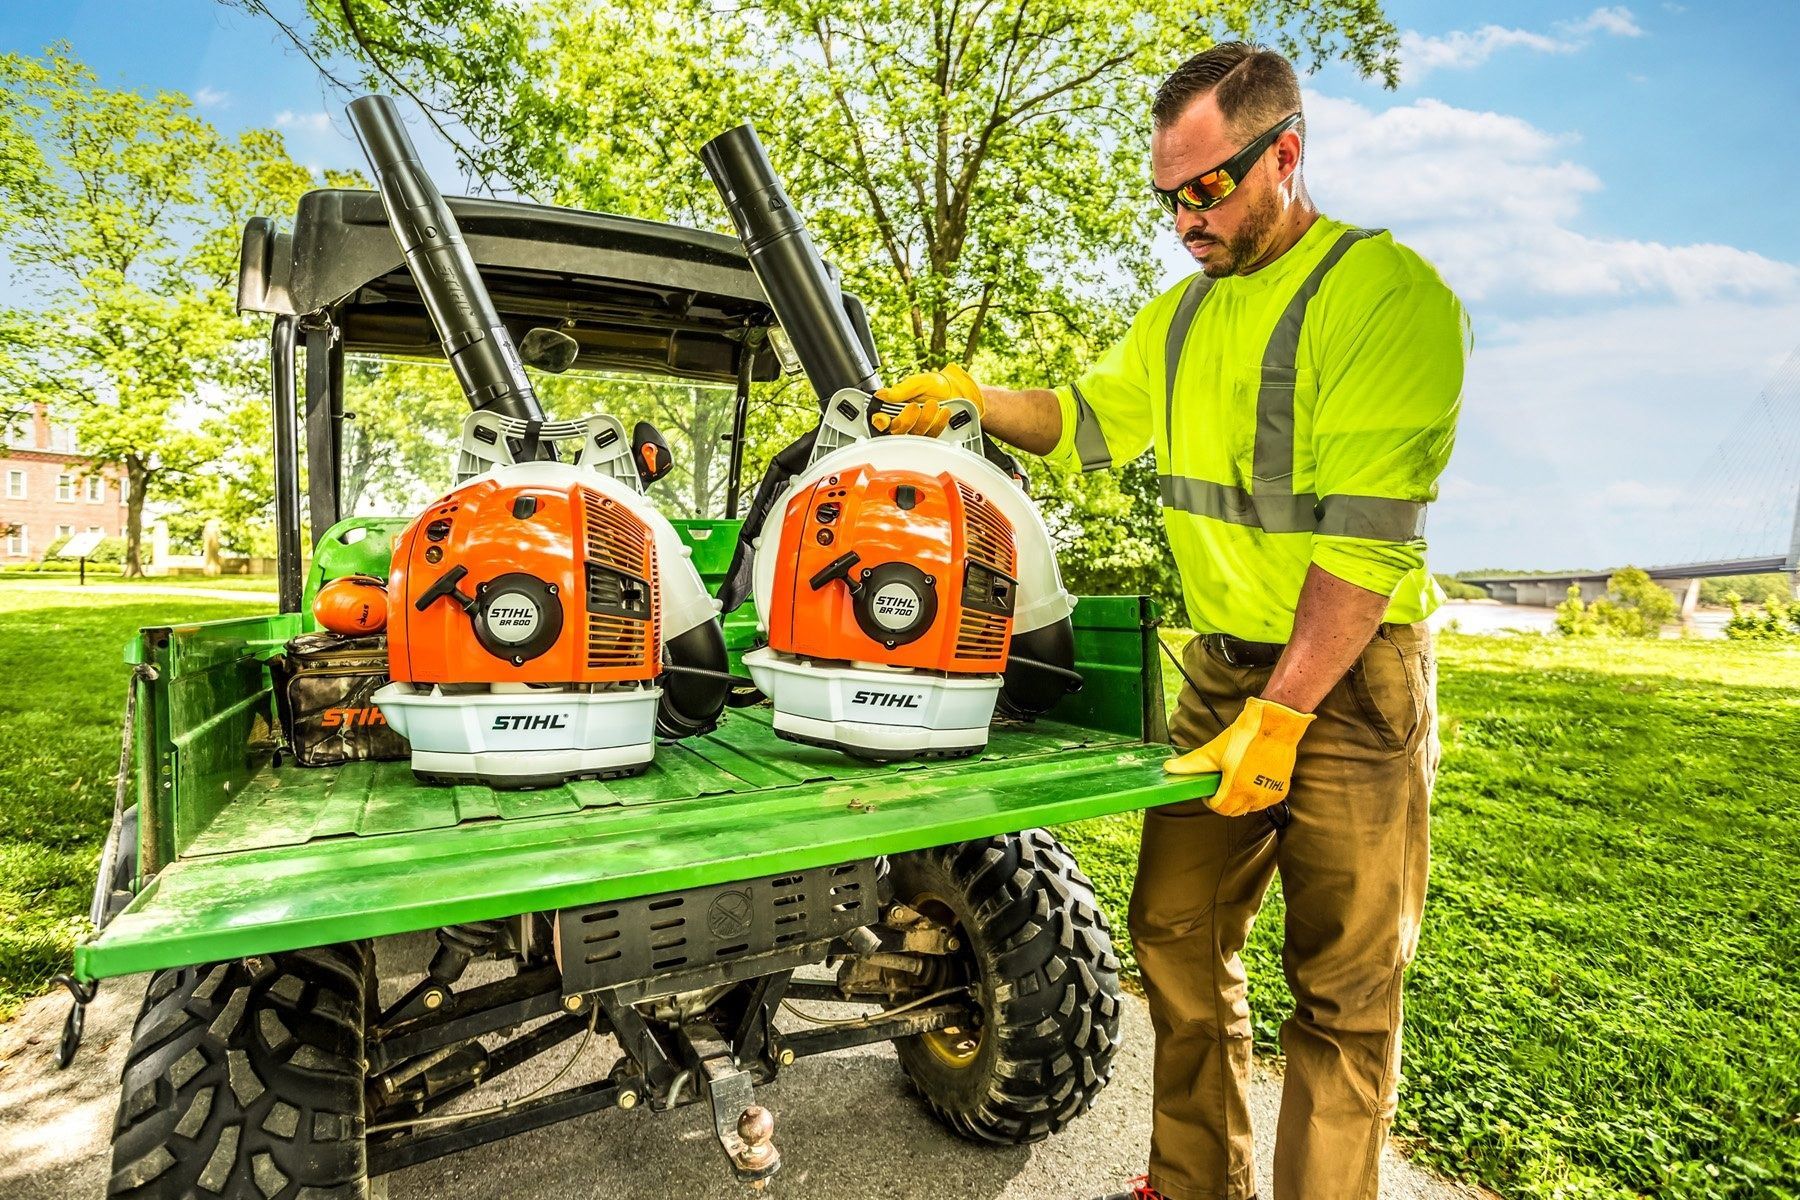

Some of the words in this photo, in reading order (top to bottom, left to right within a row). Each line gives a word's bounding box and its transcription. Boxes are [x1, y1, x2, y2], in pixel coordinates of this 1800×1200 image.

[875, 596, 915, 608] STIHL
[490, 608, 533, 618] STIHL
[879, 607, 893, 615] BR
[894, 608, 913, 616] 700
[851, 690, 918, 708] STIHL
[321, 706, 387, 727] STIH
[492, 714, 566, 730] STIHL
[1253, 774, 1285, 792] STIHL
